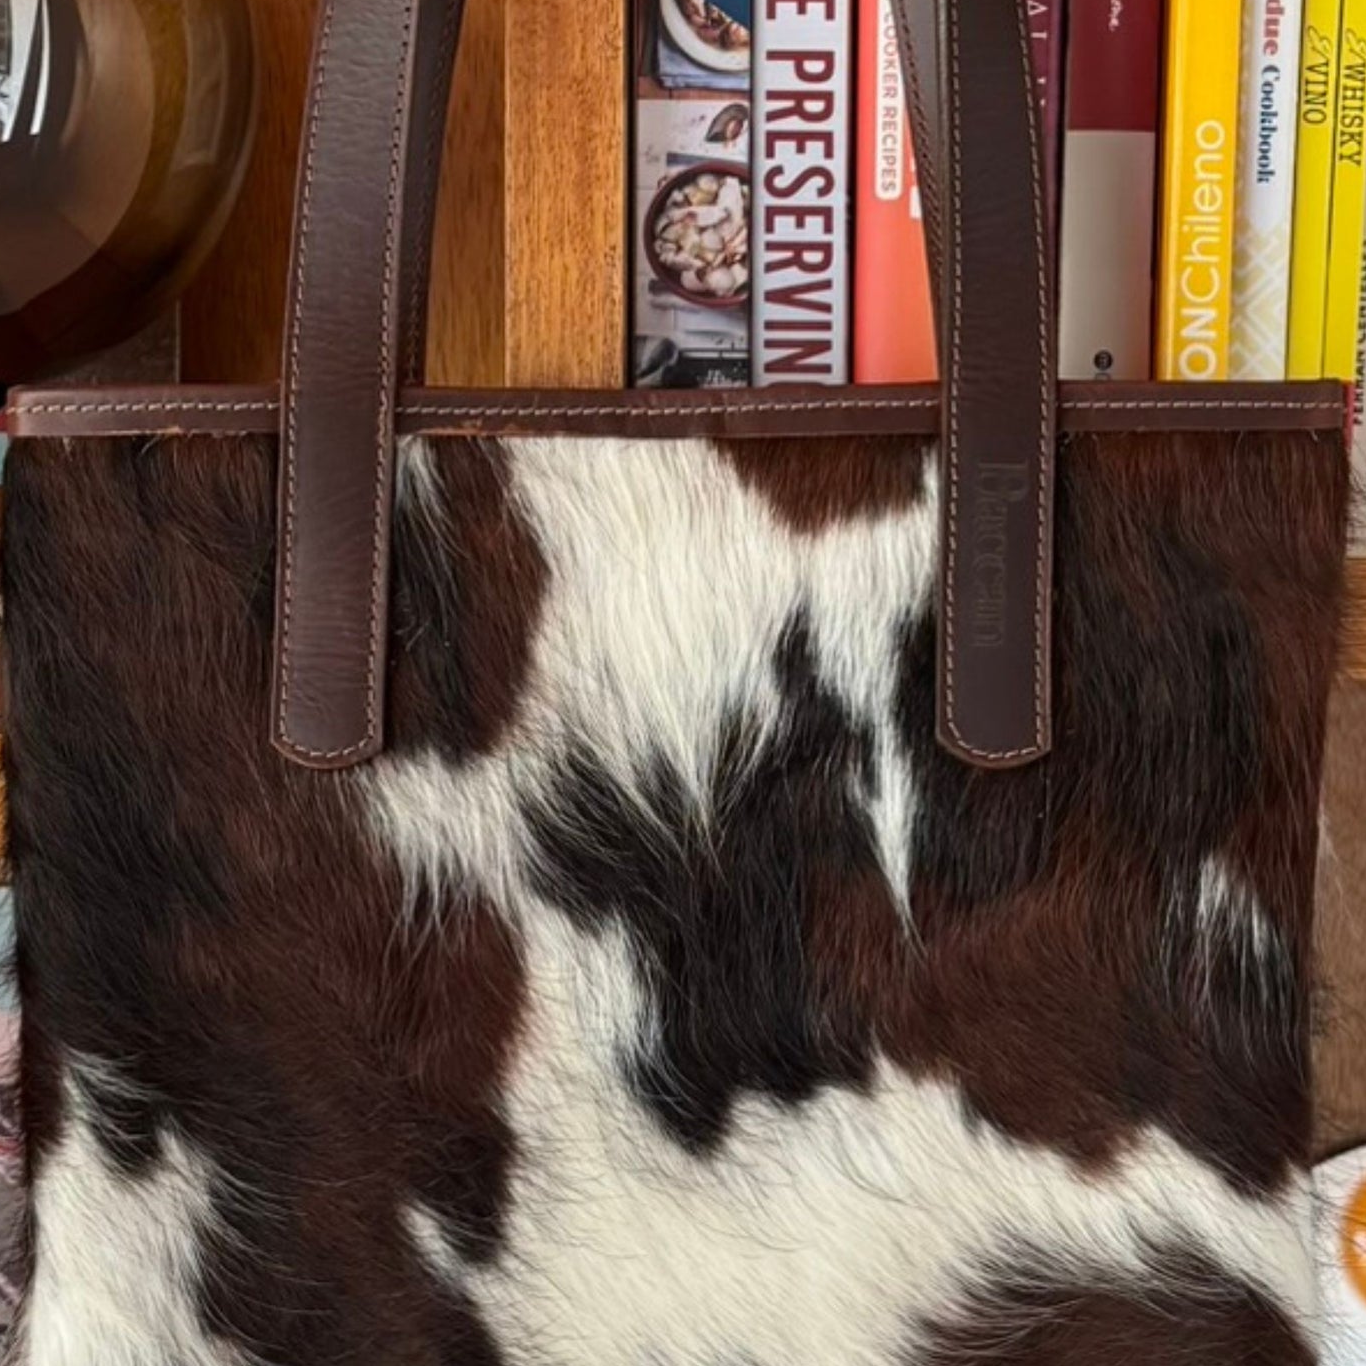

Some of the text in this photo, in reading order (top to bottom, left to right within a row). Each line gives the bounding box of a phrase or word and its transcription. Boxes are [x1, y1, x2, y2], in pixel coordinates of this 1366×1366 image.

[1256, 64, 1281, 185] Cookbook
[1303, 60, 1330, 124] VINO
[1338, 62, 1366, 166] WHISKY
[881, 107, 897, 193] RECIPES
[763, 50, 836, 386] PRESERVIN
